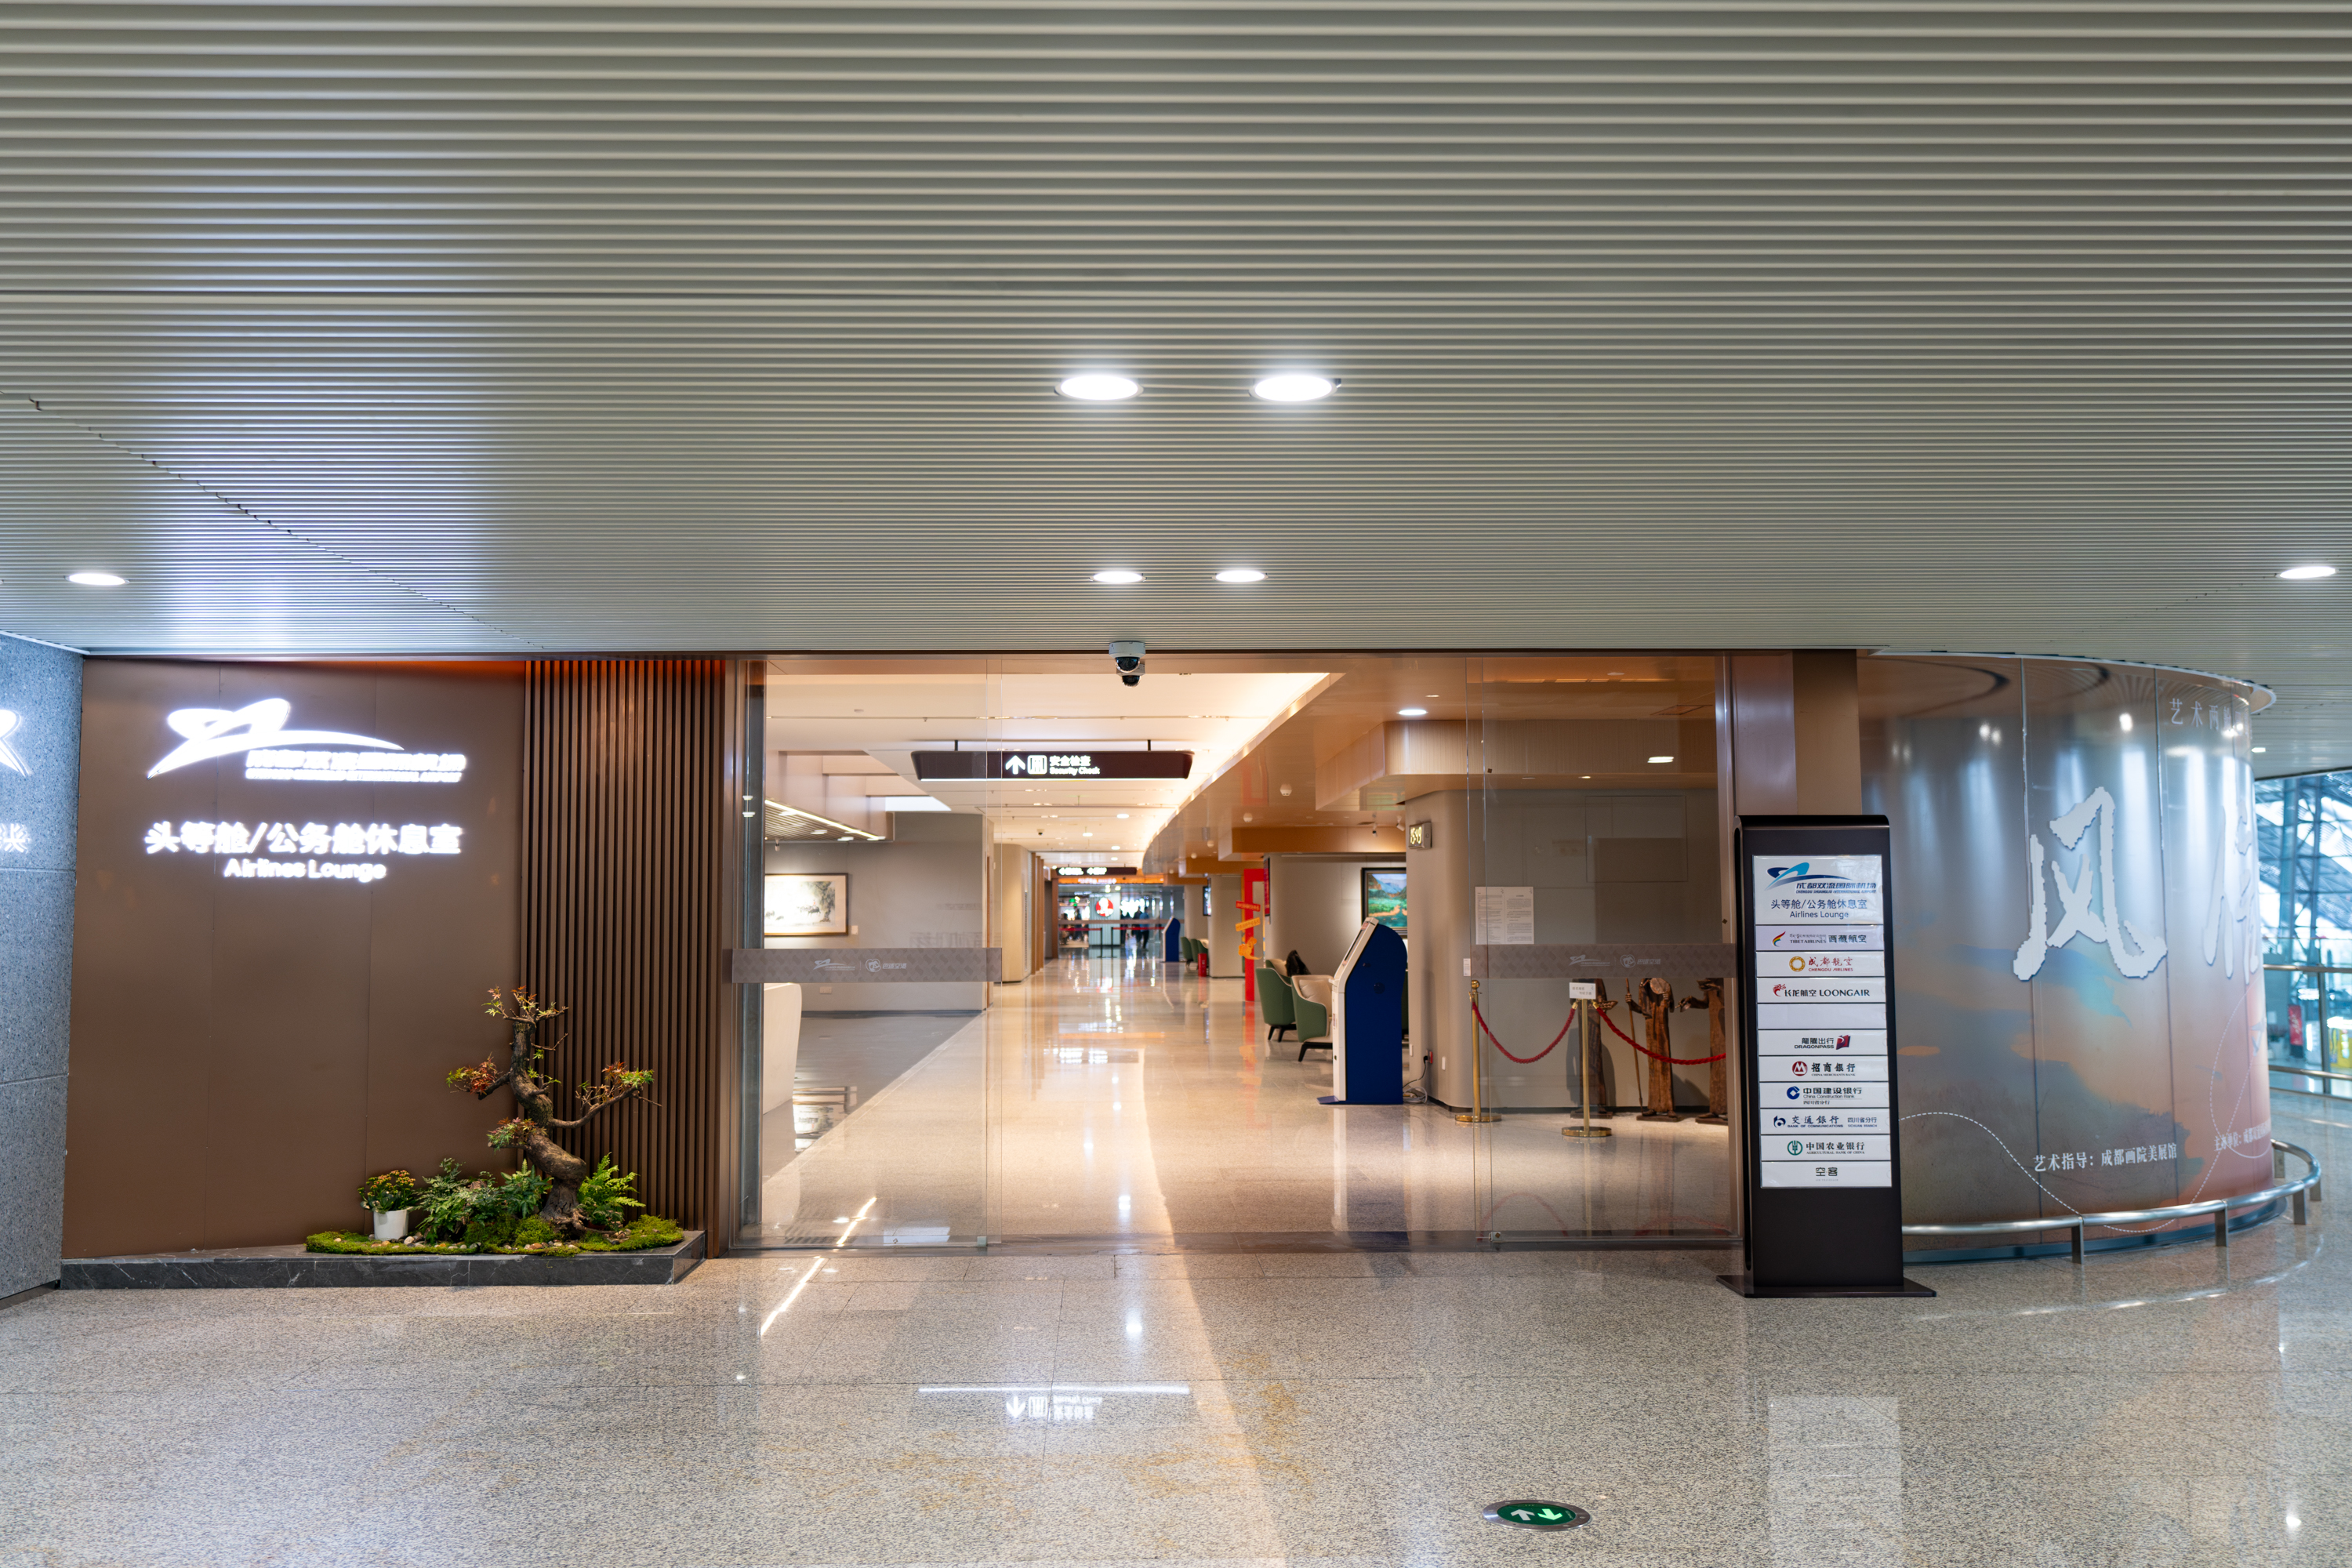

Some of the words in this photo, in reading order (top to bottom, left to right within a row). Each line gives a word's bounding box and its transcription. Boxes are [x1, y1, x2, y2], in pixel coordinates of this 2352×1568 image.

[1049, 755, 1091, 767] 安全检查
[1049, 766, 1078, 776] Security
[1078, 766, 1100, 775] Check
[144, 821, 463, 855] 头等舱/公务舱休息室
[224, 858, 306, 877] Airlines
[308, 859, 386, 883] Lounge
[1770, 899, 1867, 909] 头等舱/公务舱休息室
[1820, 911, 1849, 920] Lounge
[1828, 935, 1867, 943] 西藏航空
[1808, 956, 1853, 967] 成都航空
[1784, 989, 1817, 997] 长龙航空
[1806, 1142, 1864, 1151] 中国农业银行
